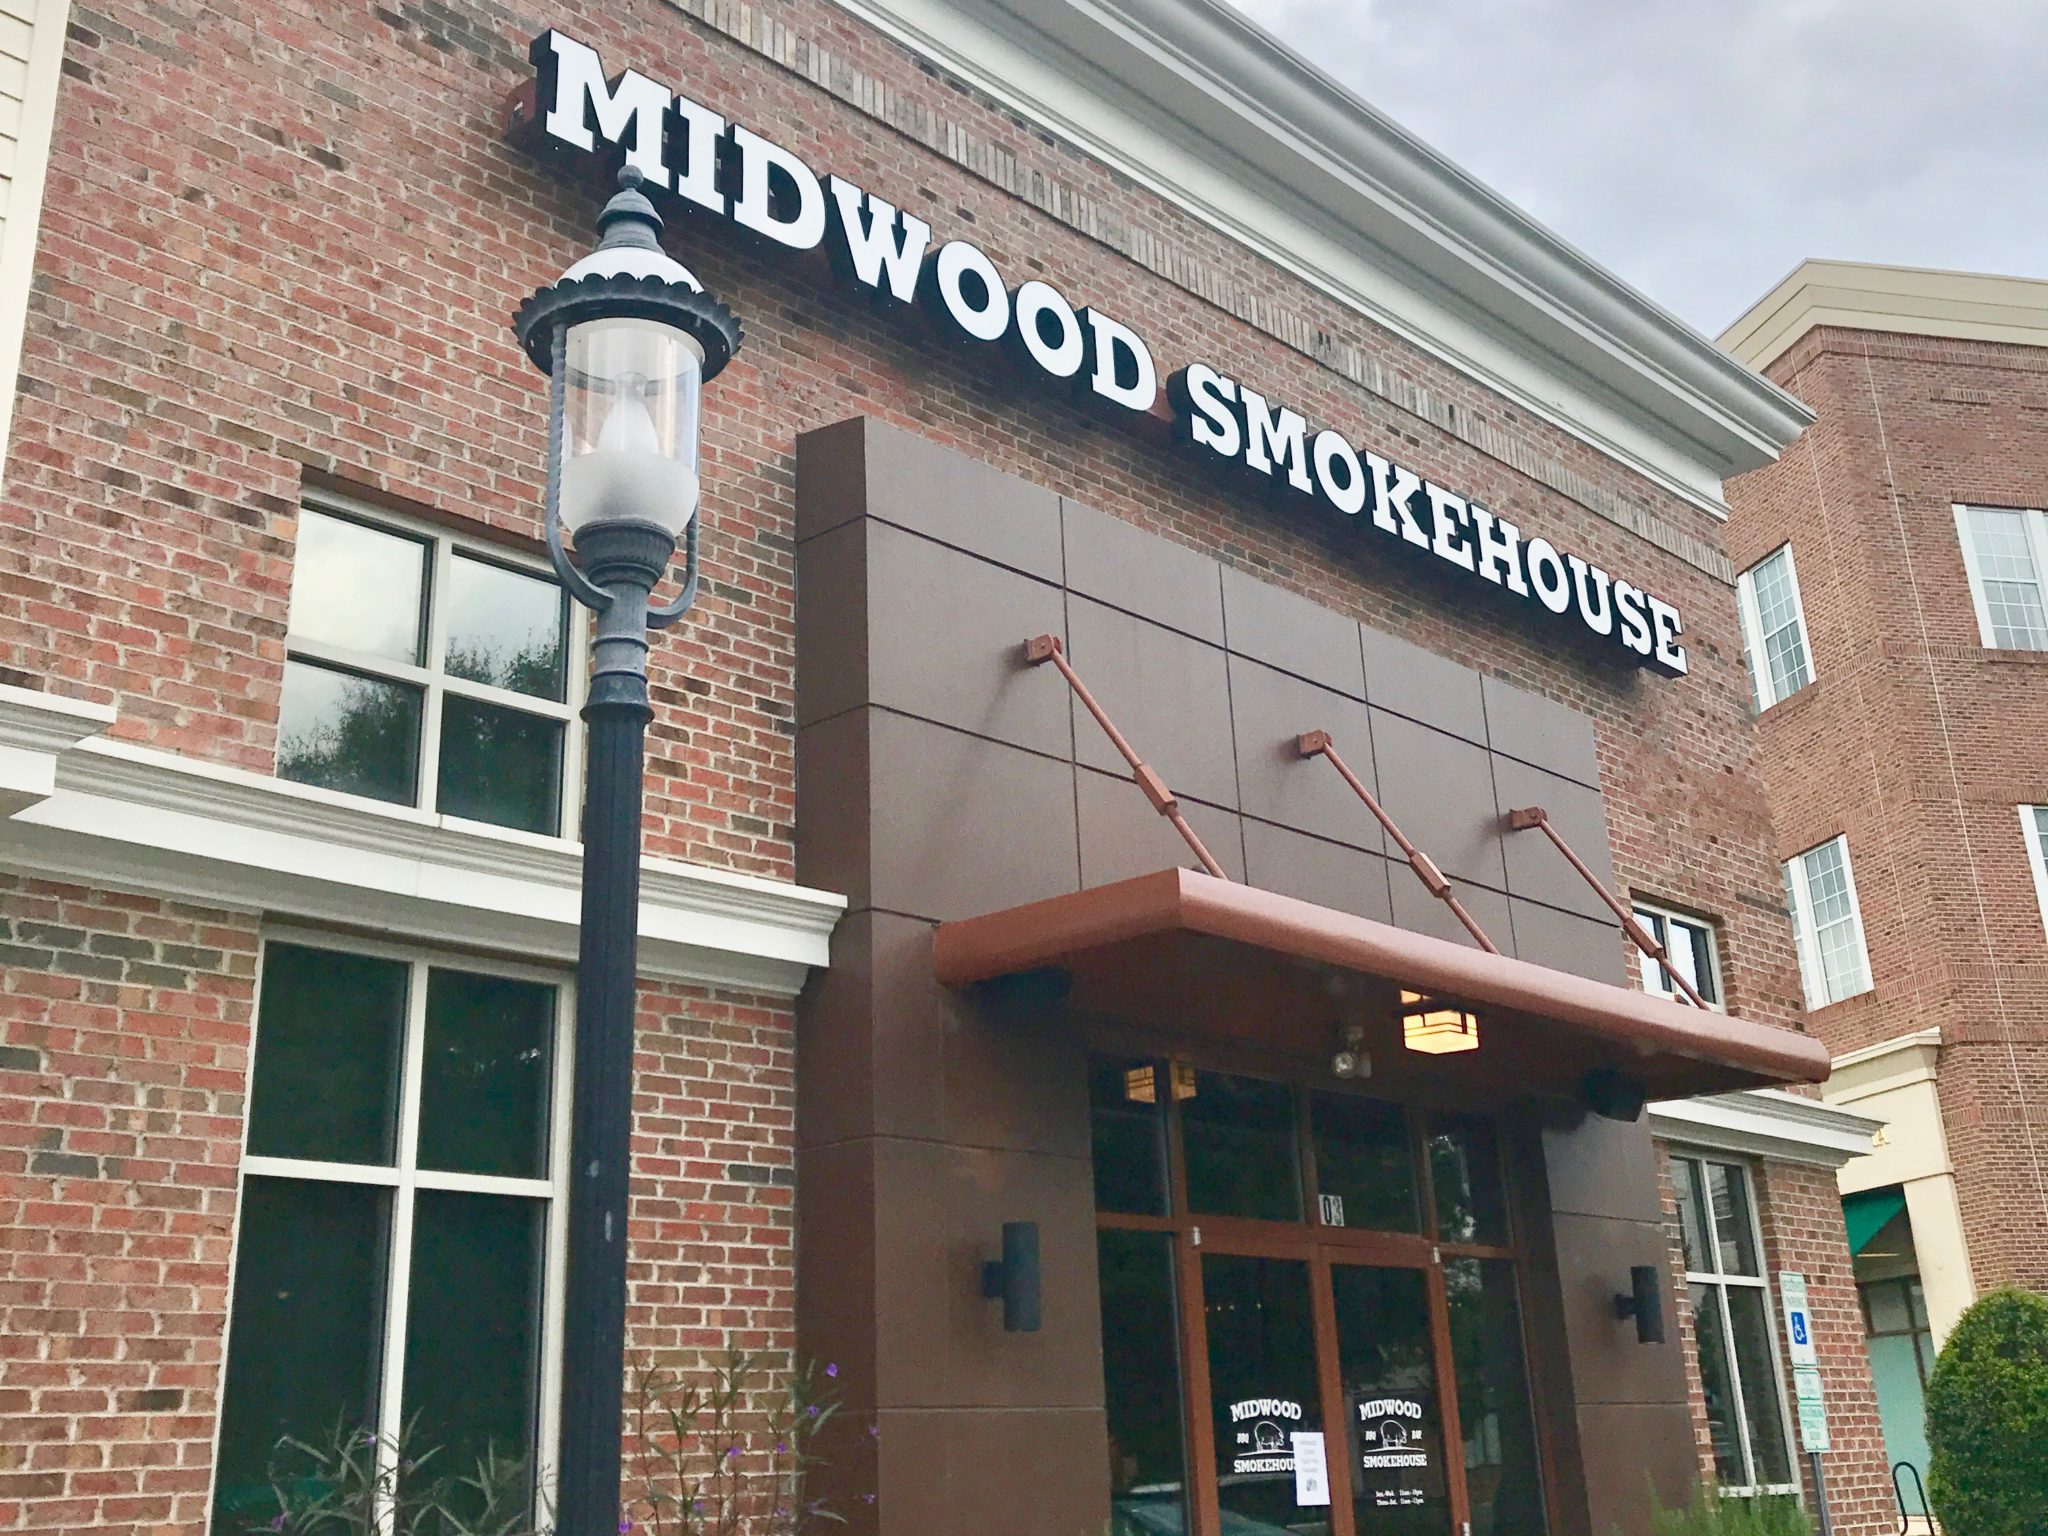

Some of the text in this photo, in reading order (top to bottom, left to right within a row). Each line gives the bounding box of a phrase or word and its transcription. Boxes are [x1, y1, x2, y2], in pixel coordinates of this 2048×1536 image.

[545, 28, 1689, 676] MIDWOOD SMOKEHOUSE
[1230, 1399, 1302, 1422] MIDWOOD
[1359, 1399, 1422, 1421] MIDWOOD
[1233, 1458, 1297, 1473] SMOKEHOU
[1363, 1454, 1428, 1468] SMOKEHOUSE
